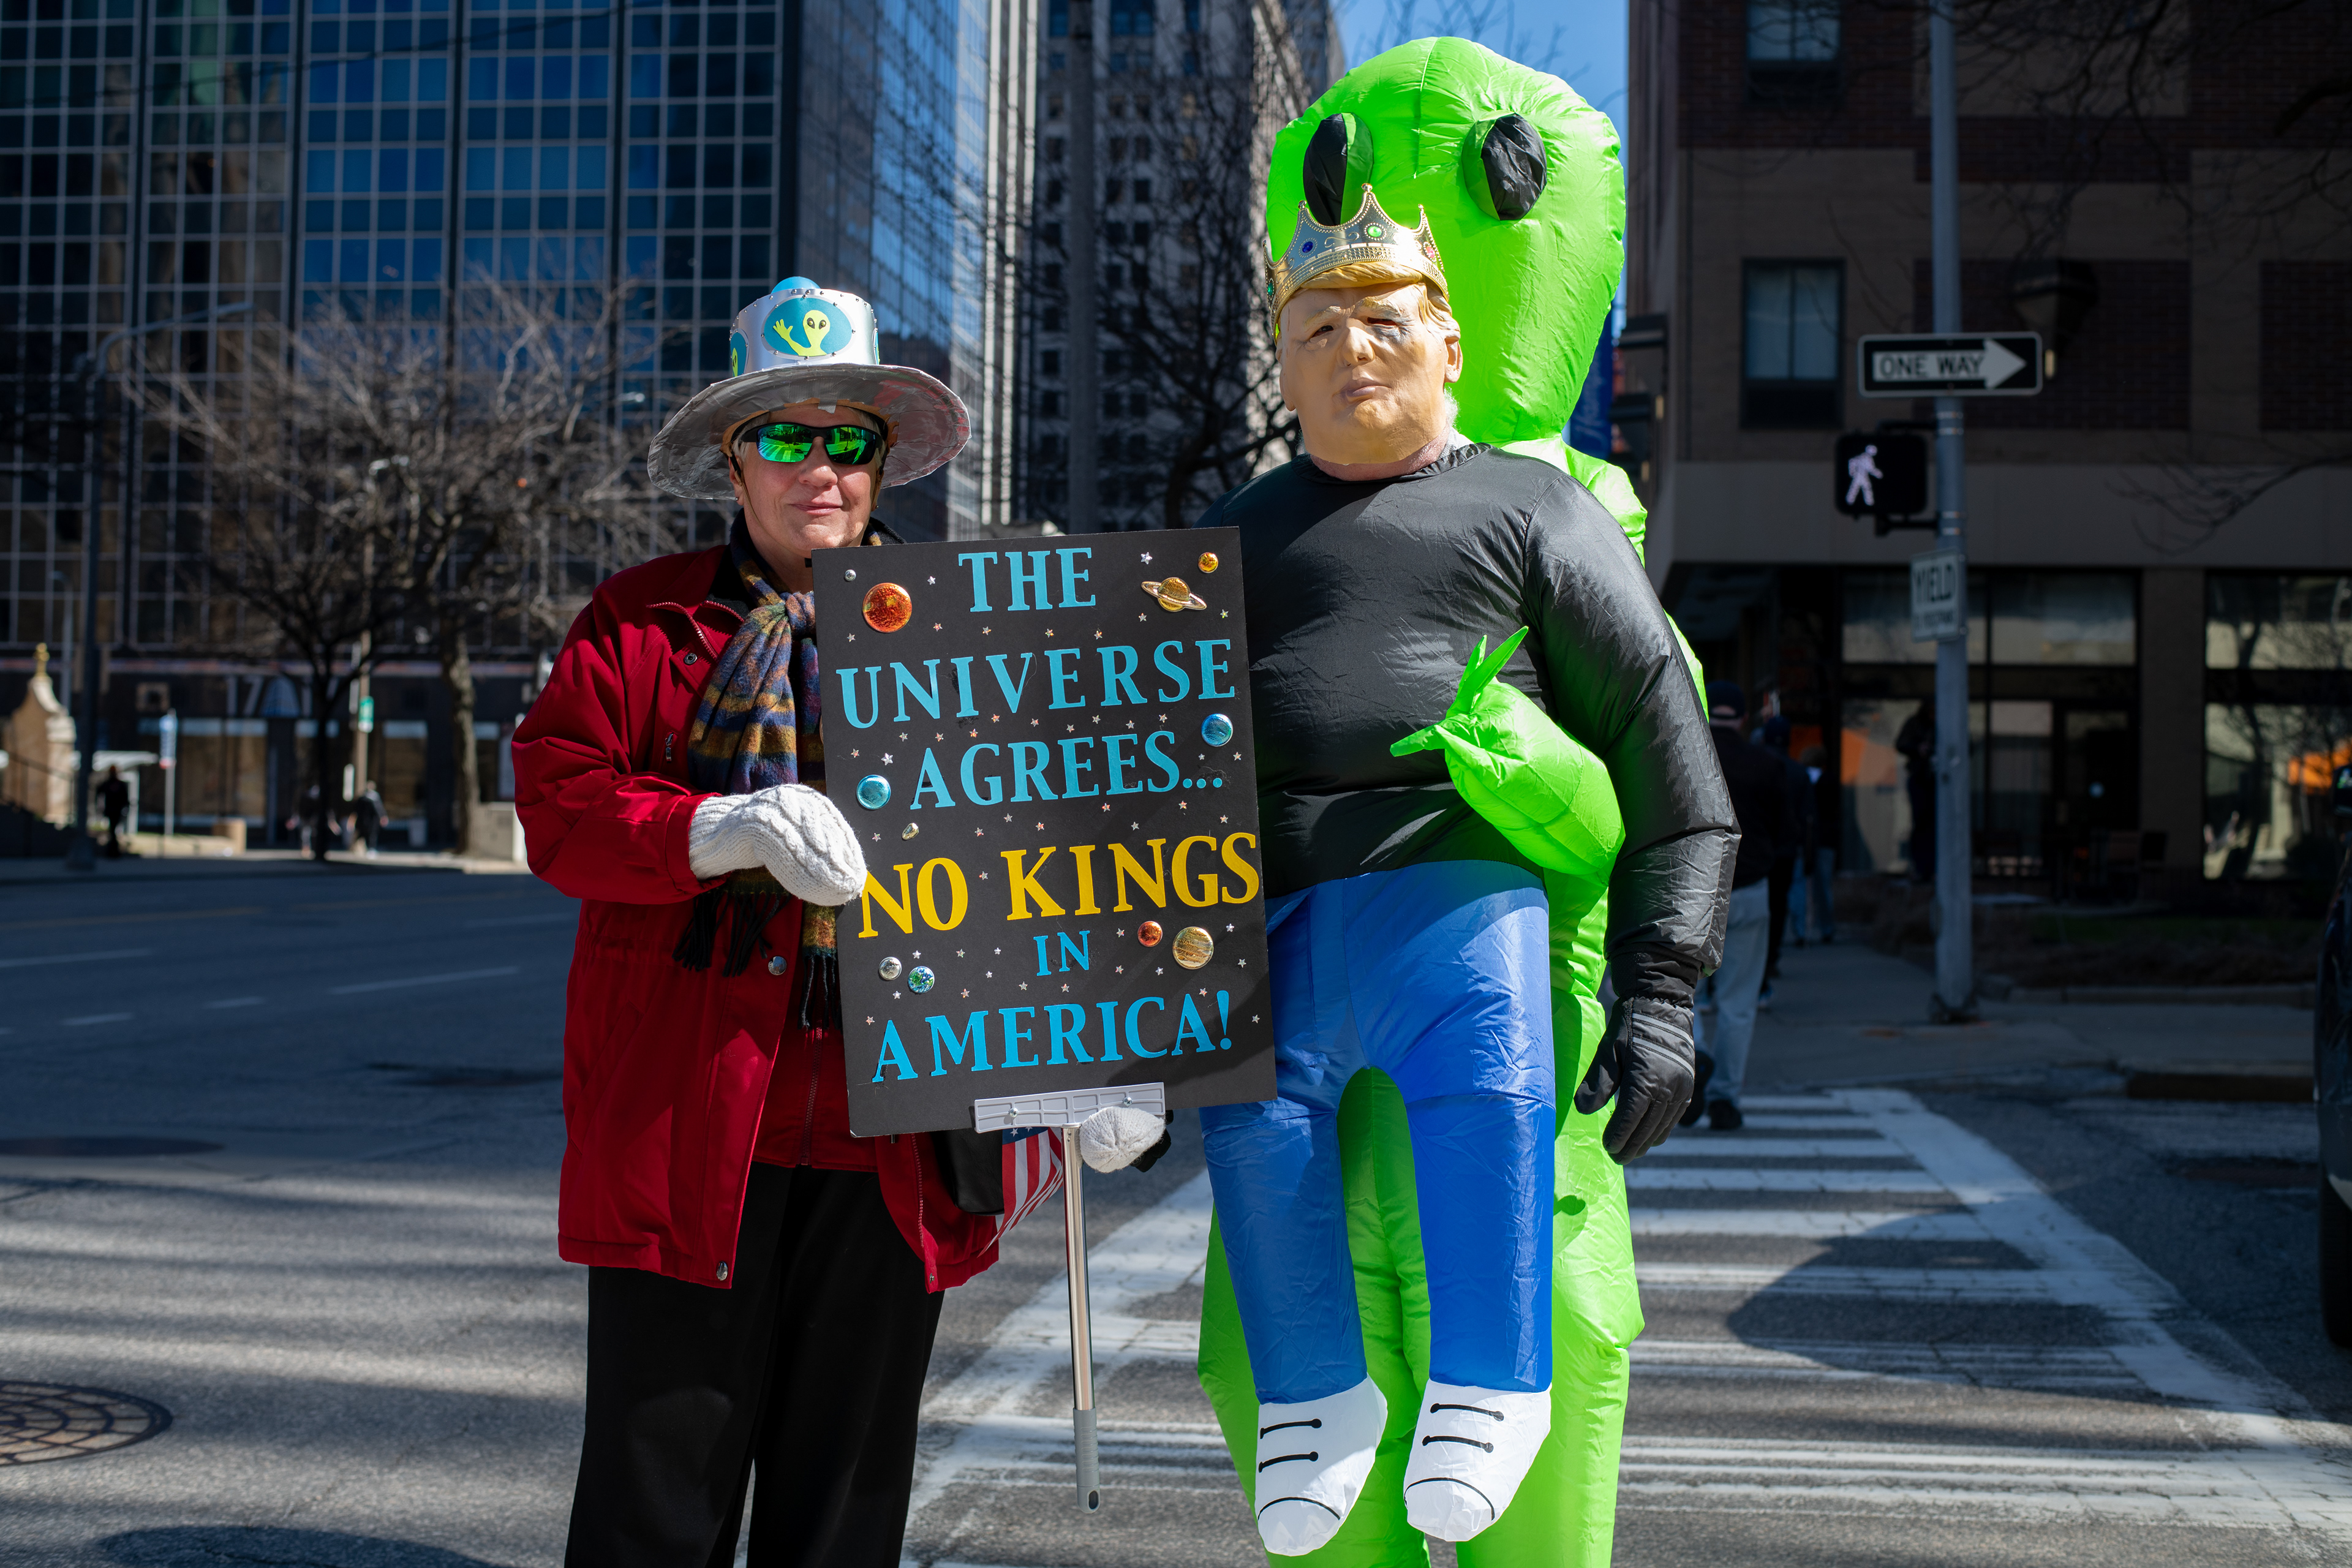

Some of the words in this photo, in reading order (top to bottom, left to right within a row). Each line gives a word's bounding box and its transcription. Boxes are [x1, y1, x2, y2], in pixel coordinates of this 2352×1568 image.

[1880, 355, 1927, 378] ONE
[1937, 355, 1985, 376] WAY
[958, 547, 1096, 612] THE
[1913, 563, 1953, 603] YIELD
[836, 639, 1235, 729] UNIVERSE
[910, 731, 1223, 810] AGREES...
[858, 857, 968, 938] NO
[1000, 832, 1259, 920] KINGS
[1033, 930, 1091, 976] IN
[872, 990, 1232, 1083] AMERICA!
